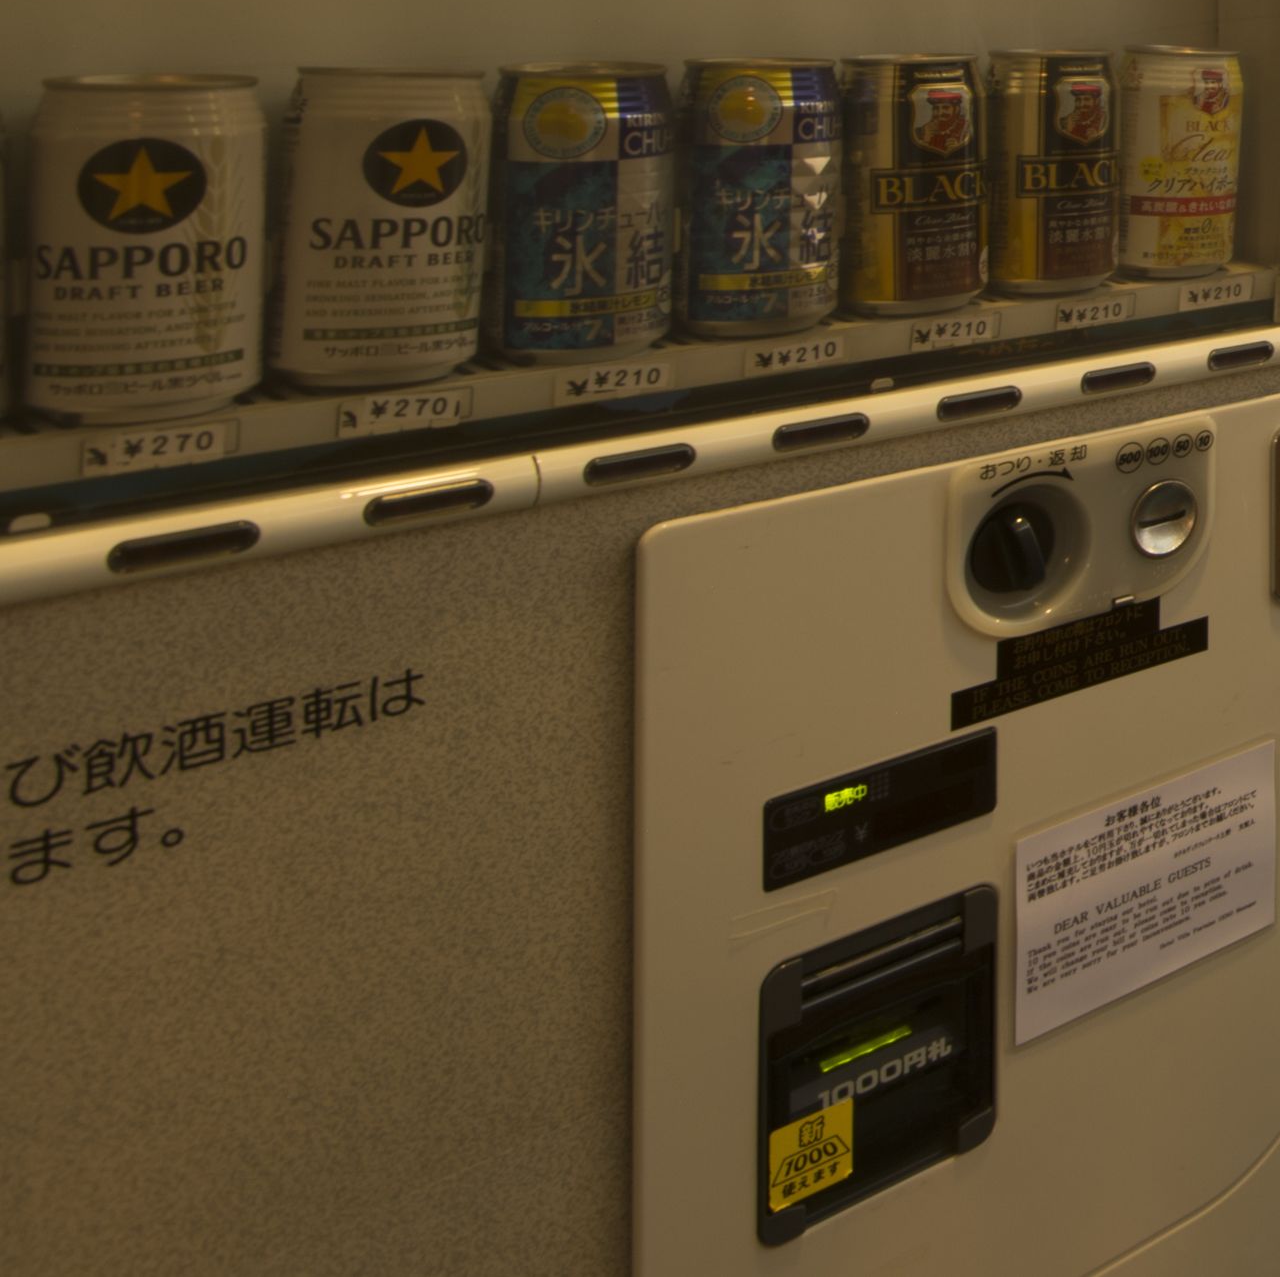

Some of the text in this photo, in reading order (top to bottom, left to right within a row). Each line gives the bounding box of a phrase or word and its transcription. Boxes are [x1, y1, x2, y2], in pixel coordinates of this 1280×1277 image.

[1186, 119, 1231, 133] BLACK
[308, 213, 486, 251] SAPPORO
[730, 209, 834, 271] 氷結
[36, 236, 247, 281] SAPPORO
[332, 250, 475, 270] DRAFT BEER
[550, 227, 665, 297] 氷結
[53, 278, 225, 302] DRAFT BEER
[1202, 283, 1242, 302] ¥210
[935, 320, 986, 339] ¥210
[1076, 302, 1122, 322] ¥210
[777, 341, 837, 365] ¥210
[595, 367, 662, 390] ¥210
[369, 396, 449, 419] ¥270
[123, 430, 214, 459] ¥270
[979, 443, 1088, 480] おつり・返却
[1118, 434, 1210, 466] 500 100 50 10
[972, 687, 989, 704] IF
[1000, 673, 1026, 694] THE
[1032, 661, 1078, 684] COINS
[1084, 652, 1114, 670] ARE
[1120, 638, 1149, 657] RUN
[971, 692, 1032, 720] PLEASE
[1038, 679, 1080, 698] COME
[1084, 670, 1105, 683] TO
[6, 668, 427, 808] び飲酒運転は
[1104, 794, 1161, 828] お客様各位
[8, 806, 185, 886] ます。
[1054, 855, 1211, 934] DEAR VALUABLE GUESTS
[818, 1036, 952, 1111] 1000円札
[798, 1115, 826, 1149] 新
[784, 1140, 838, 1176] 1000
[781, 1161, 840, 1198] 使えます
